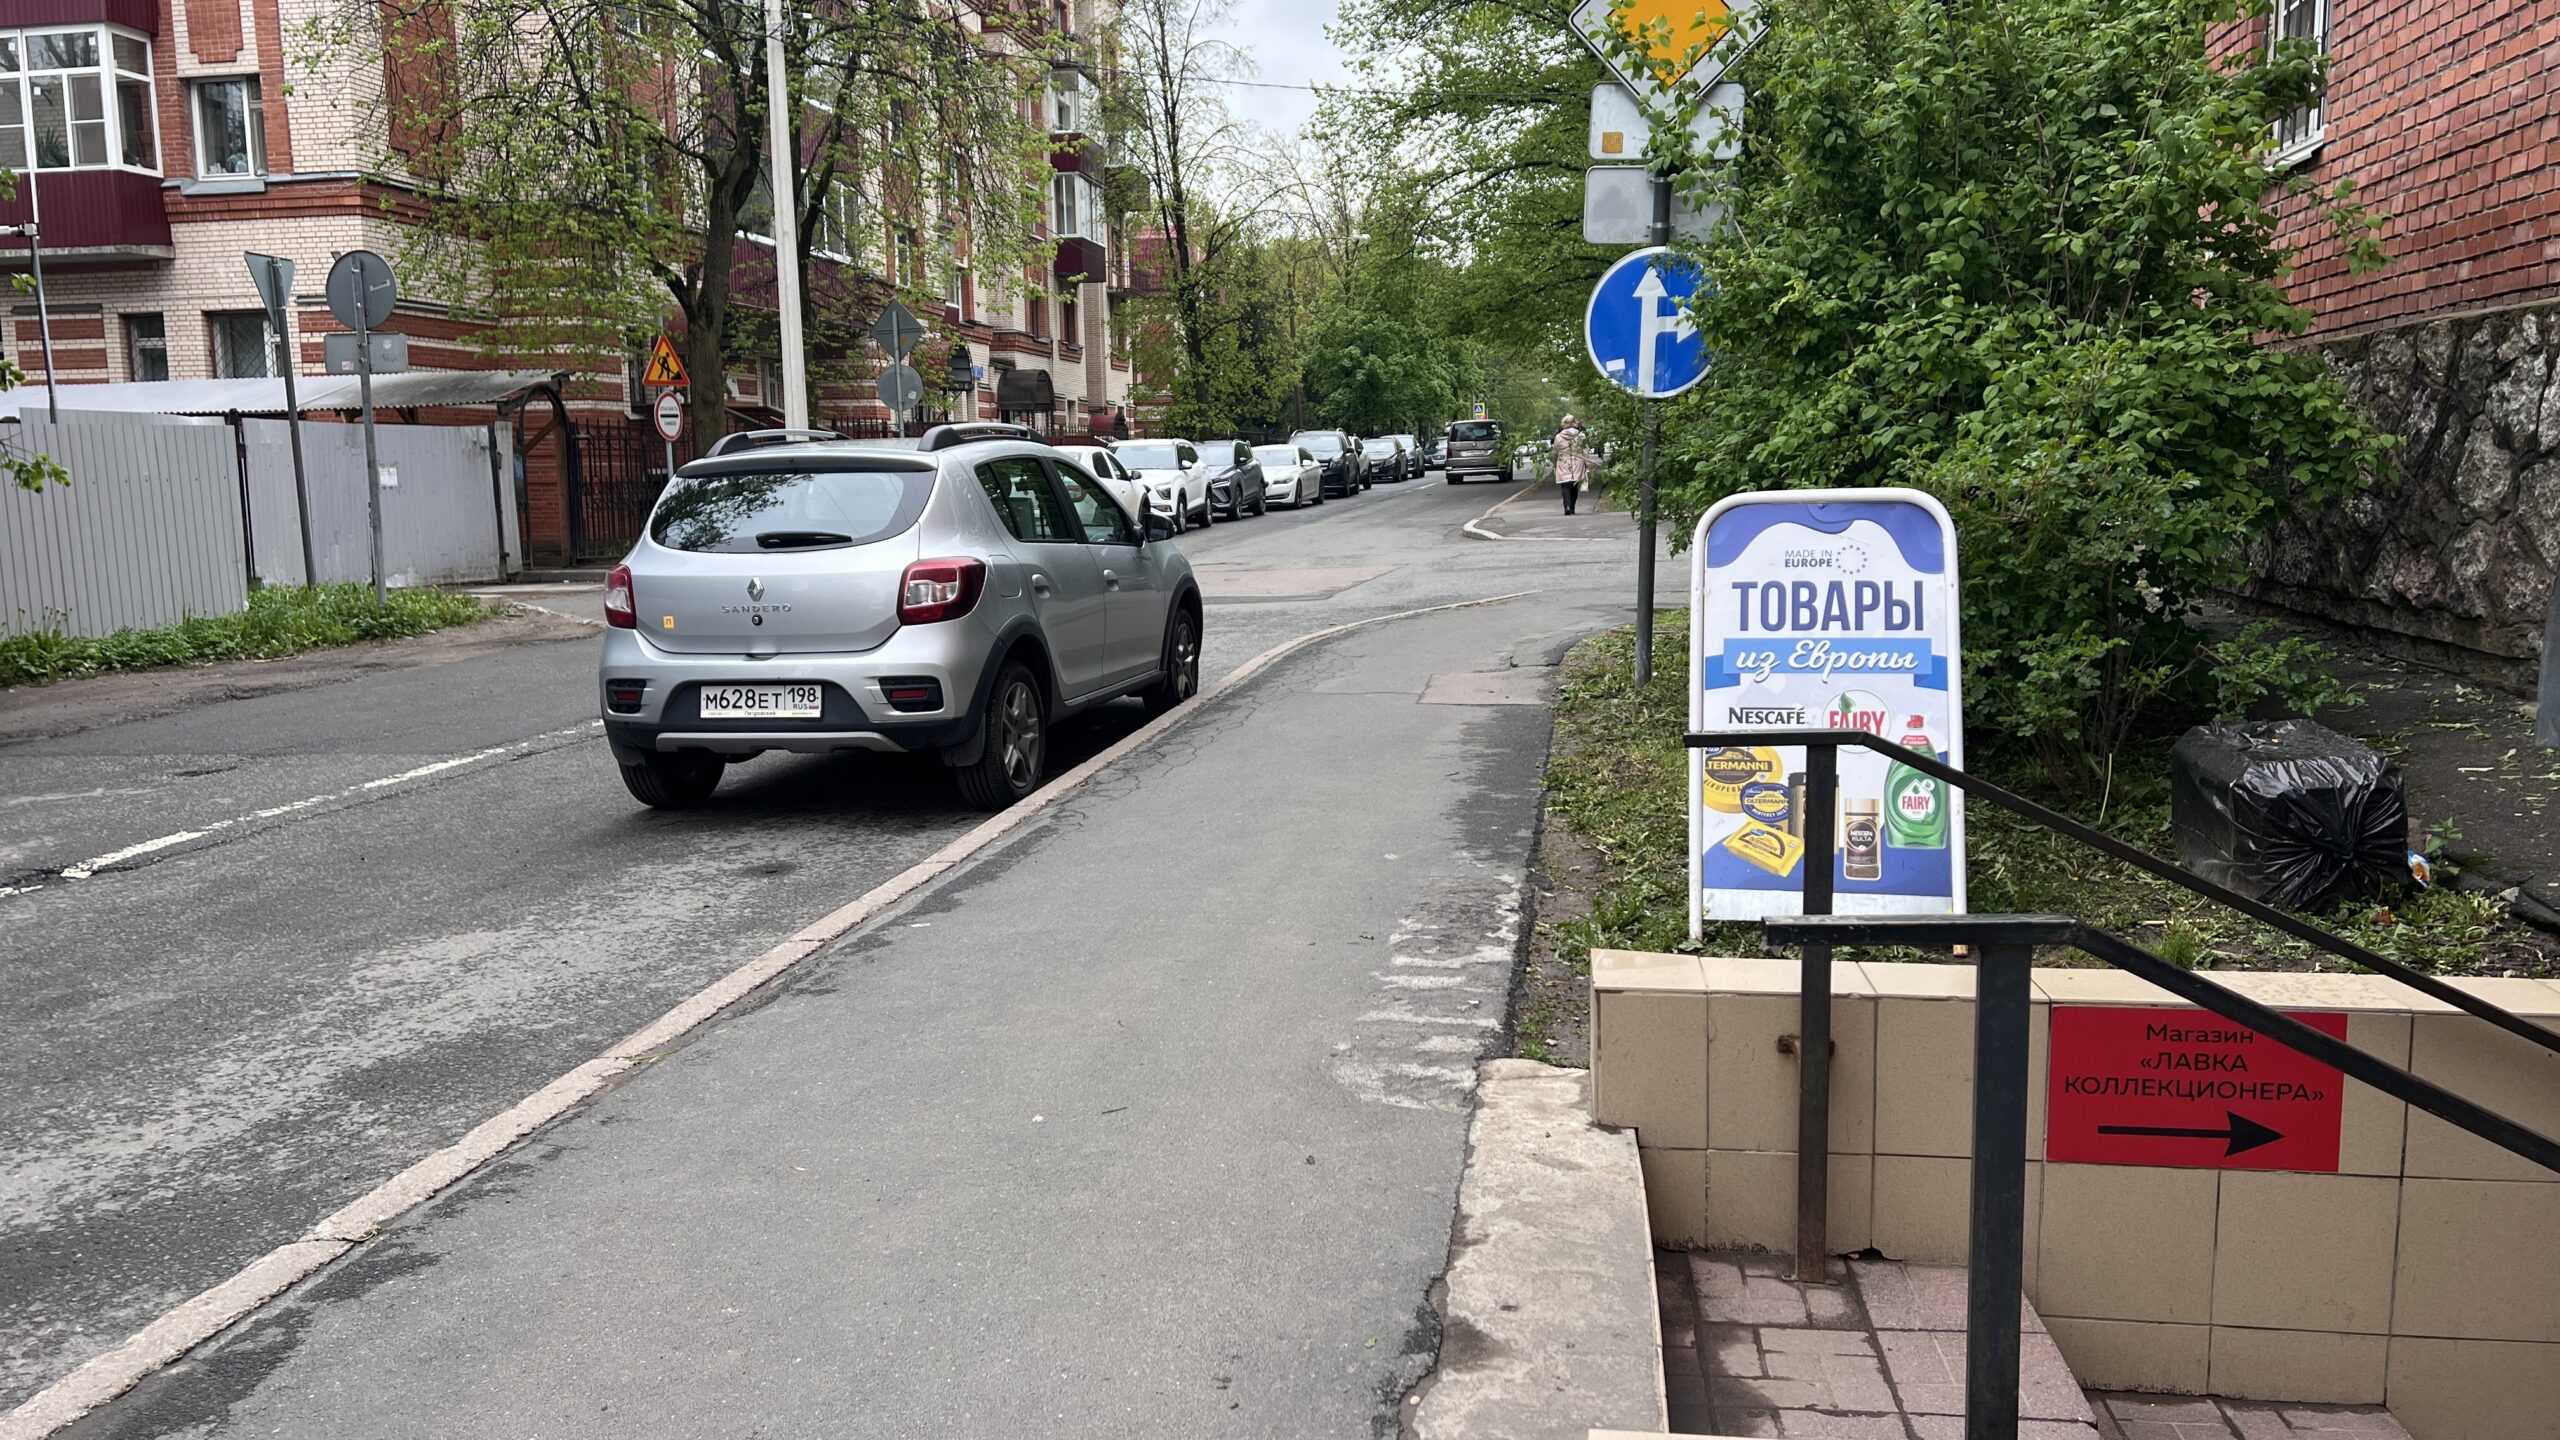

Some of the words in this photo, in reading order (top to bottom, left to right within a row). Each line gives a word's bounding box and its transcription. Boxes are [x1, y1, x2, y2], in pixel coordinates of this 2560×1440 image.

[1784, 558, 1833, 568] EUROPE
[1785, 549, 1816, 558] MADE
[1821, 549, 1833, 558] IN
[721, 603, 792, 614] SANDERO
[1731, 580, 1924, 632] ТОВАРЫ
[1735, 651, 1781, 684] из
[1788, 639, 1919, 685] Европы
[787, 687, 817, 703] 198
[1728, 706, 1806, 725] NESCAFÉ
[1829, 710, 1886, 737] FAIRY
[1705, 760, 1769, 771] TERMANNI
[1902, 795, 1931, 810] FAIRY
[2146, 1023, 2254, 1044] Магазин
[2140, 1051, 2248, 1072] «ЛАВКА
[2064, 1075, 2325, 1102] КОЛЛЕКЦИОНЕРА»
